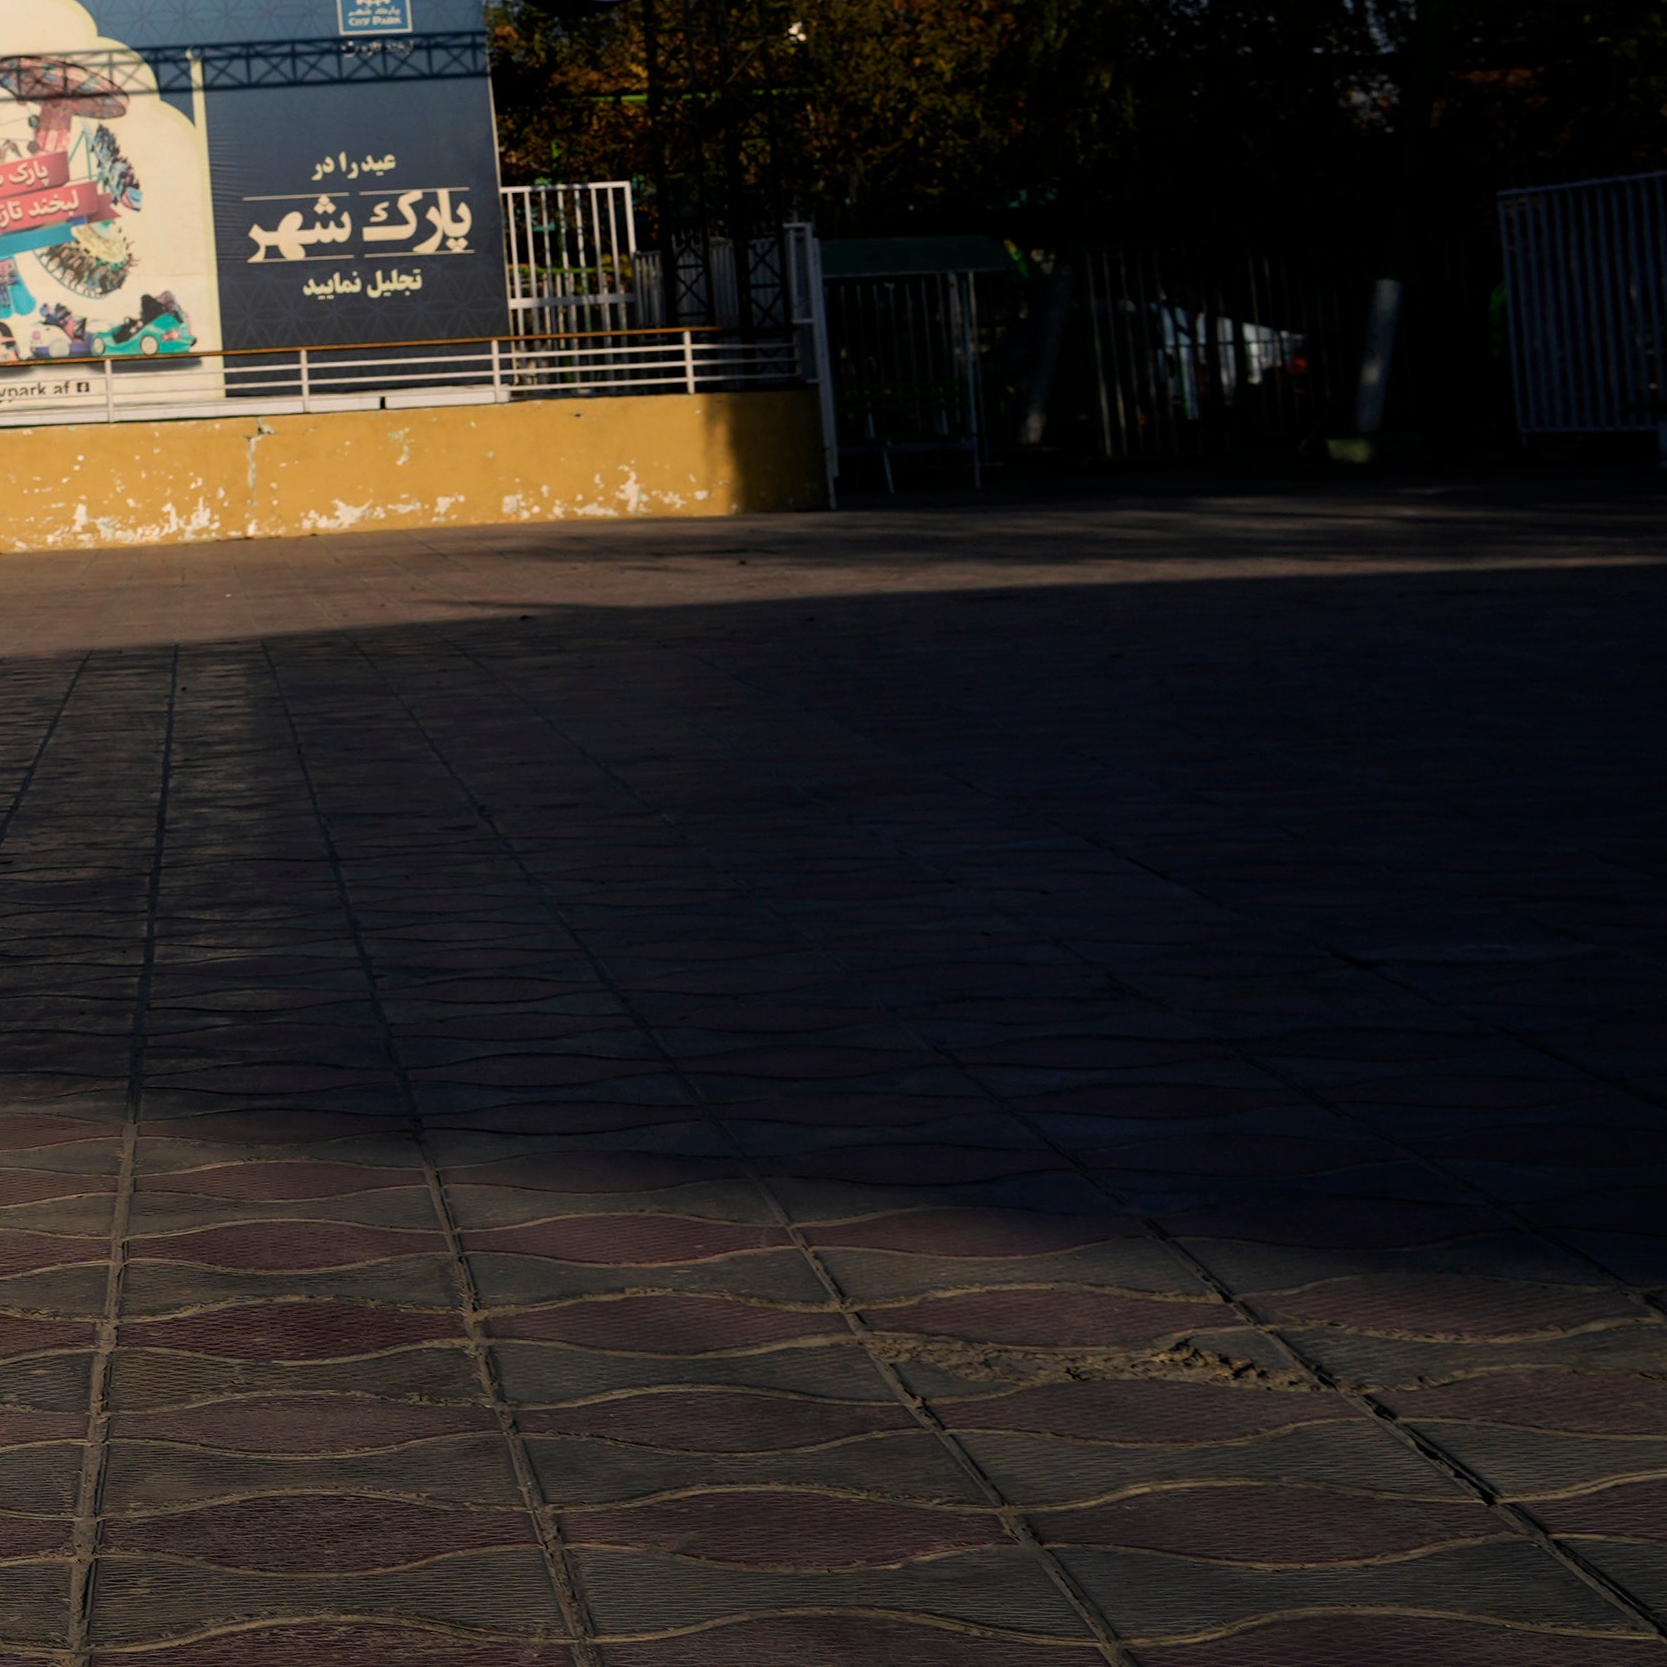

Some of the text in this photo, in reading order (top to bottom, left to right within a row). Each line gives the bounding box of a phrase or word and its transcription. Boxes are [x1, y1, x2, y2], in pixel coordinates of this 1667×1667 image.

[9, 160, 49, 186] پارک
[311, 151, 396, 181] عید را در
[28, 189, 80, 216] لبخند
[247, 193, 352, 263] شهر
[302, 269, 423, 300] تجلیل نمایید
